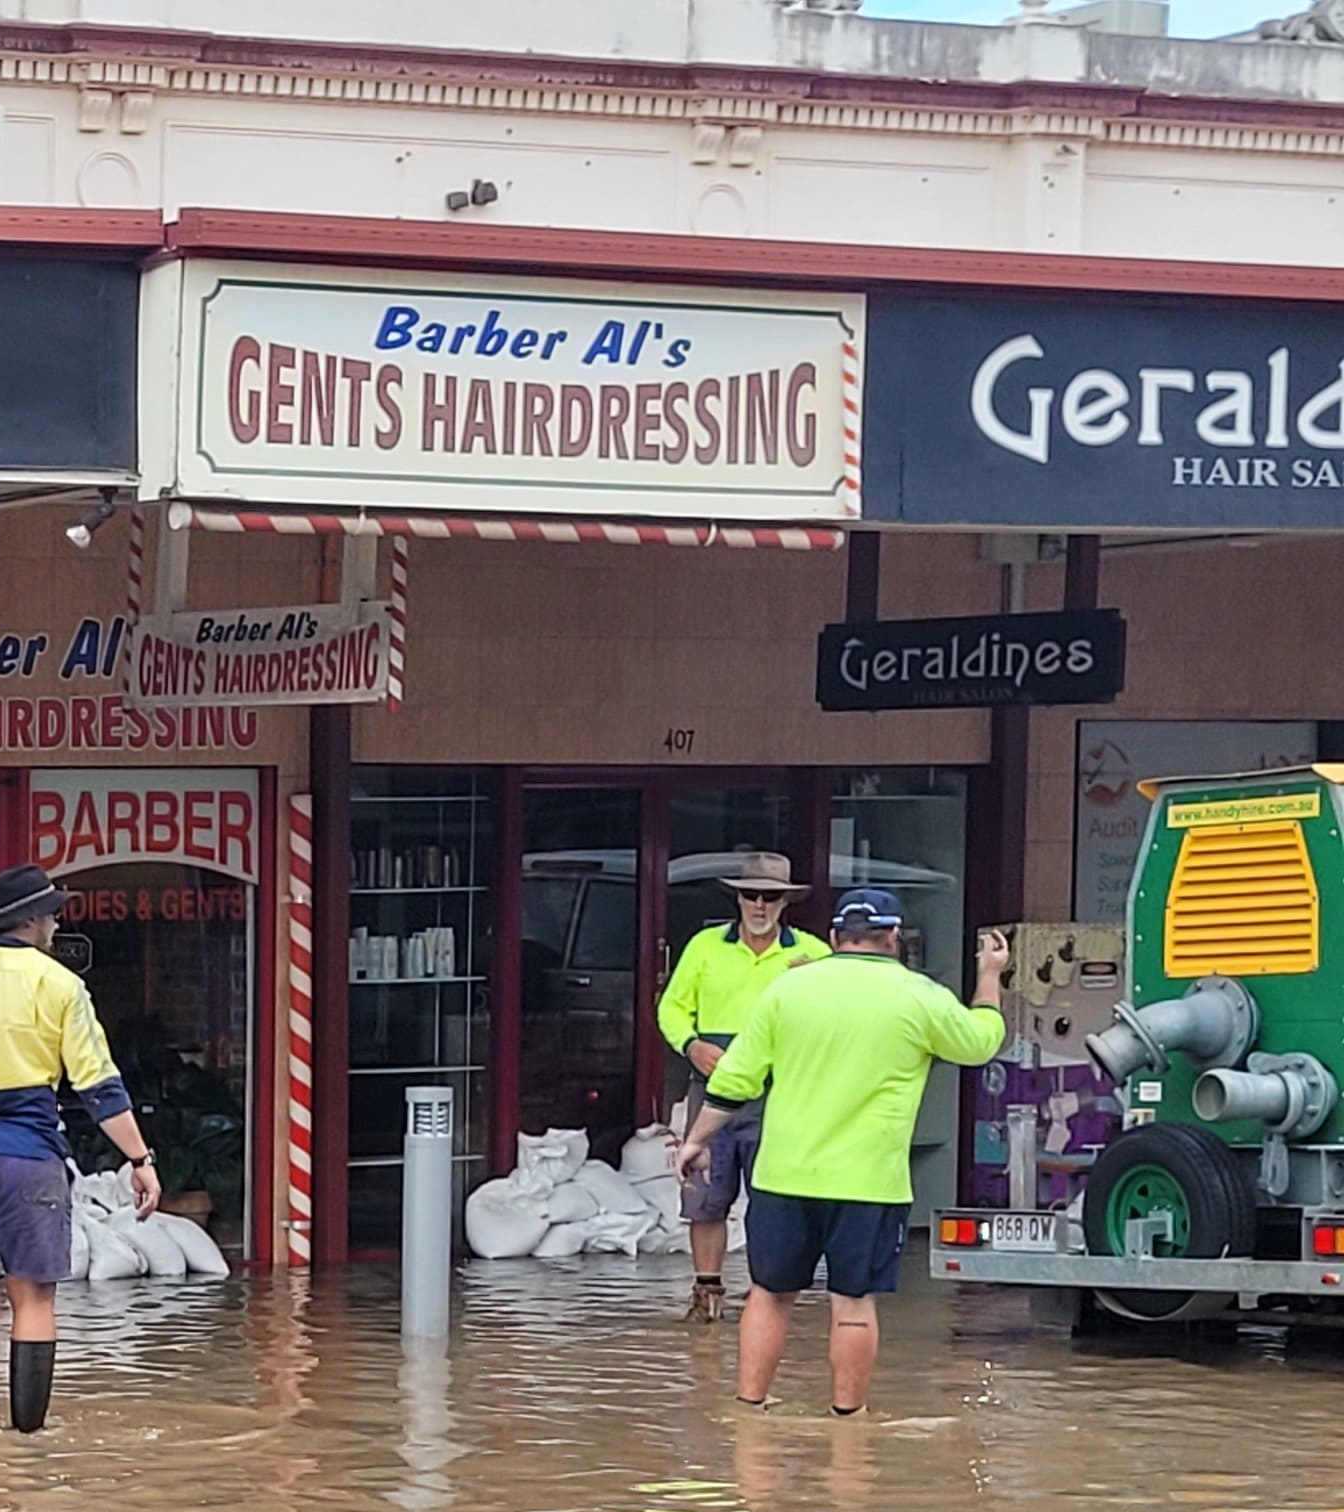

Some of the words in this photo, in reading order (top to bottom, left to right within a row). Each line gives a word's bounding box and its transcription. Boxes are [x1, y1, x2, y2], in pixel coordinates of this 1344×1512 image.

[374, 306, 567, 361] Barber
[581, 320, 692, 368] Al's
[228, 335, 403, 452] GENTS
[421, 360, 817, 467] HAIRDRESSING
[1172, 456, 1280, 488] HAIR
[195, 613, 272, 644] Barber
[275, 611, 318, 641] Al's
[138, 633, 205, 697] GENTS
[214, 621, 380, 694] HAIRDRESSING
[839, 632, 1094, 690] Geraldines
[663, 727, 695, 754] 407
[31, 790, 254, 875] BARBER
[135, 889, 154, 921] &
[160, 889, 248, 921] GENTS
